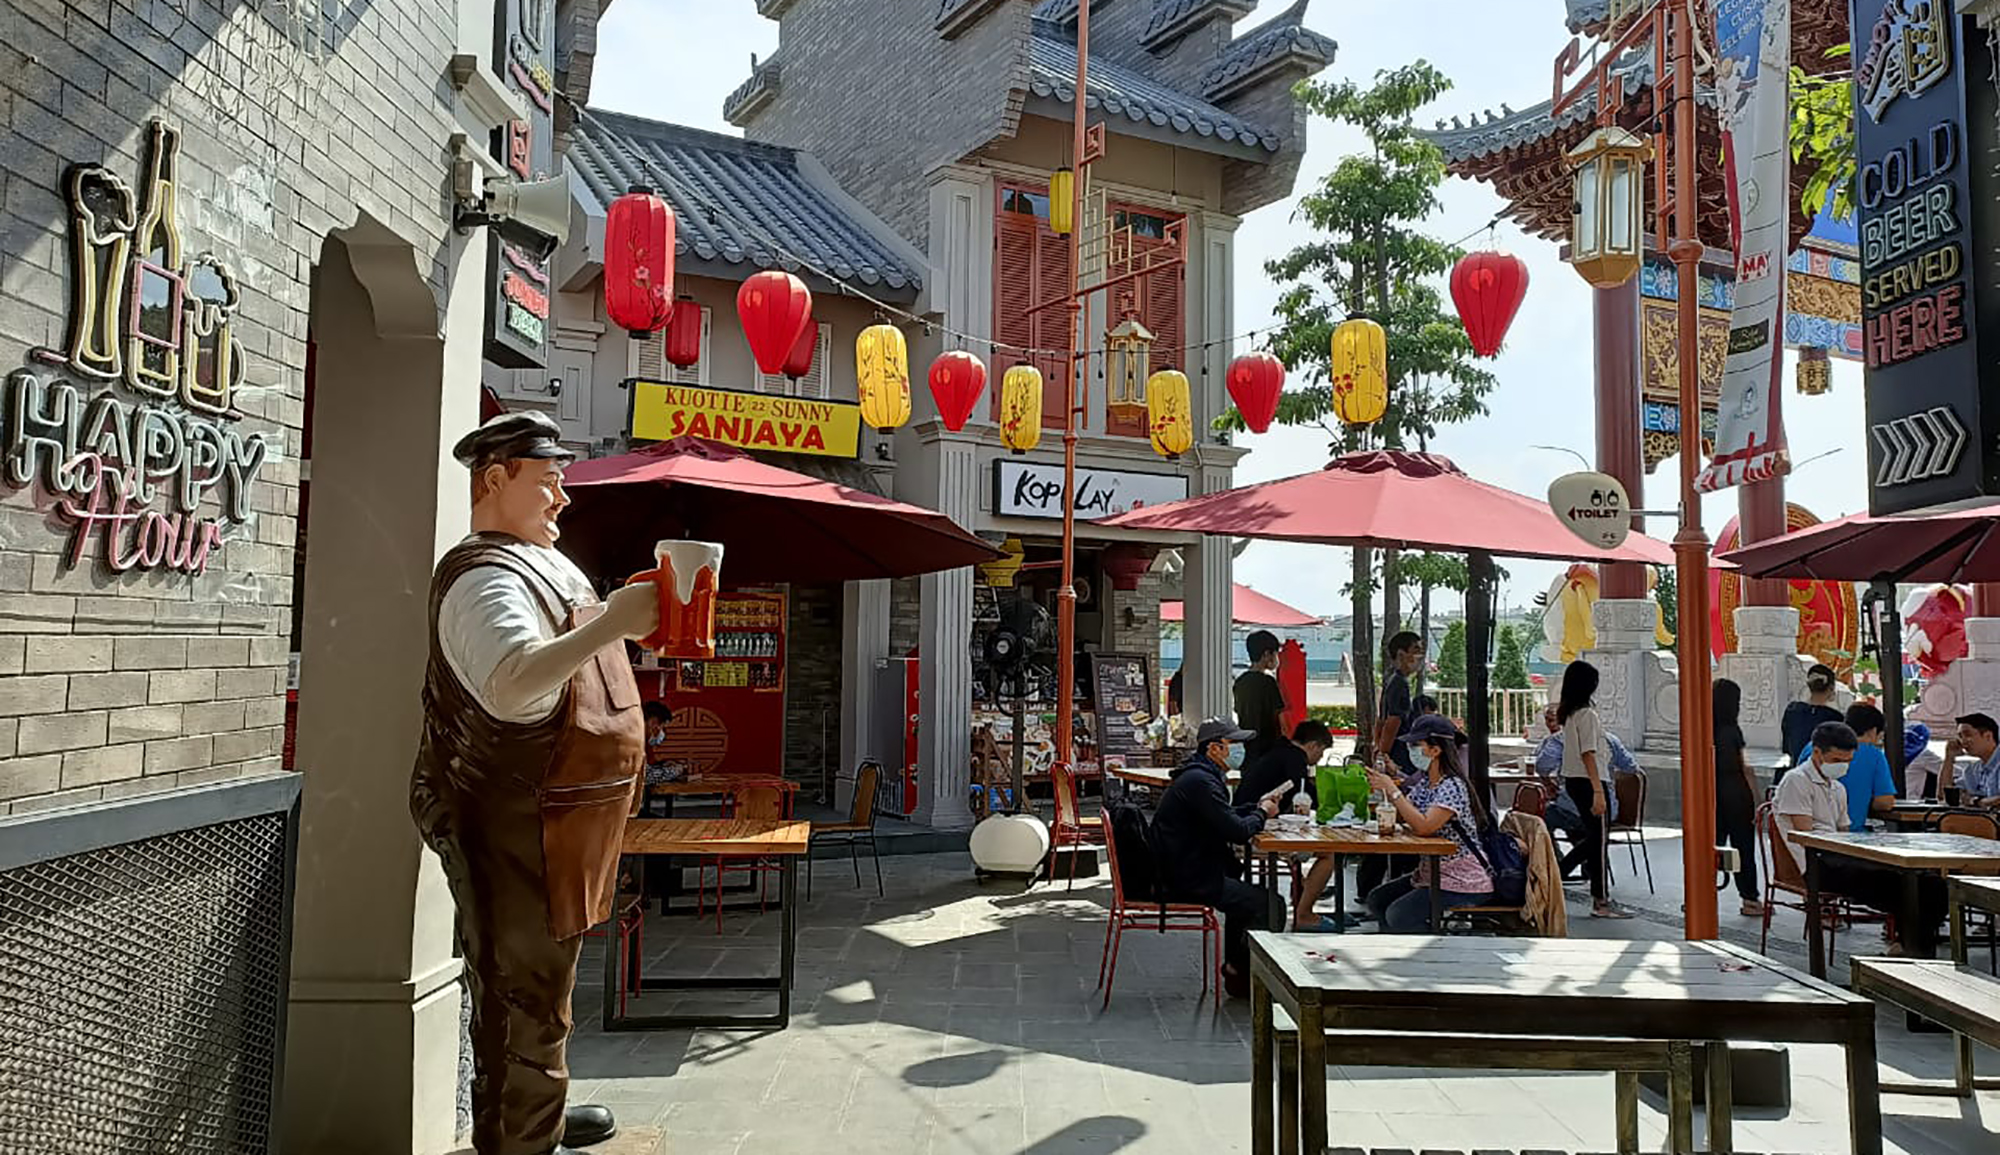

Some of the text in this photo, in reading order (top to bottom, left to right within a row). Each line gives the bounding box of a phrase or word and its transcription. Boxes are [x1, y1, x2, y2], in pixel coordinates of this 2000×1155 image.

[1860, 123, 1957, 209] COLD
[1862, 184, 1958, 269] BEER
[1865, 246, 1959, 309] SERVED
[1867, 286, 1964, 367] HERE
[664, 387, 834, 423] KUOTIE 22 SUNNY
[670, 410, 826, 450] SANJAYA
[8, 374, 267, 519] HAPPY
[61, 452, 222, 573] Hour
[1576, 508, 1619, 519] TOILET
